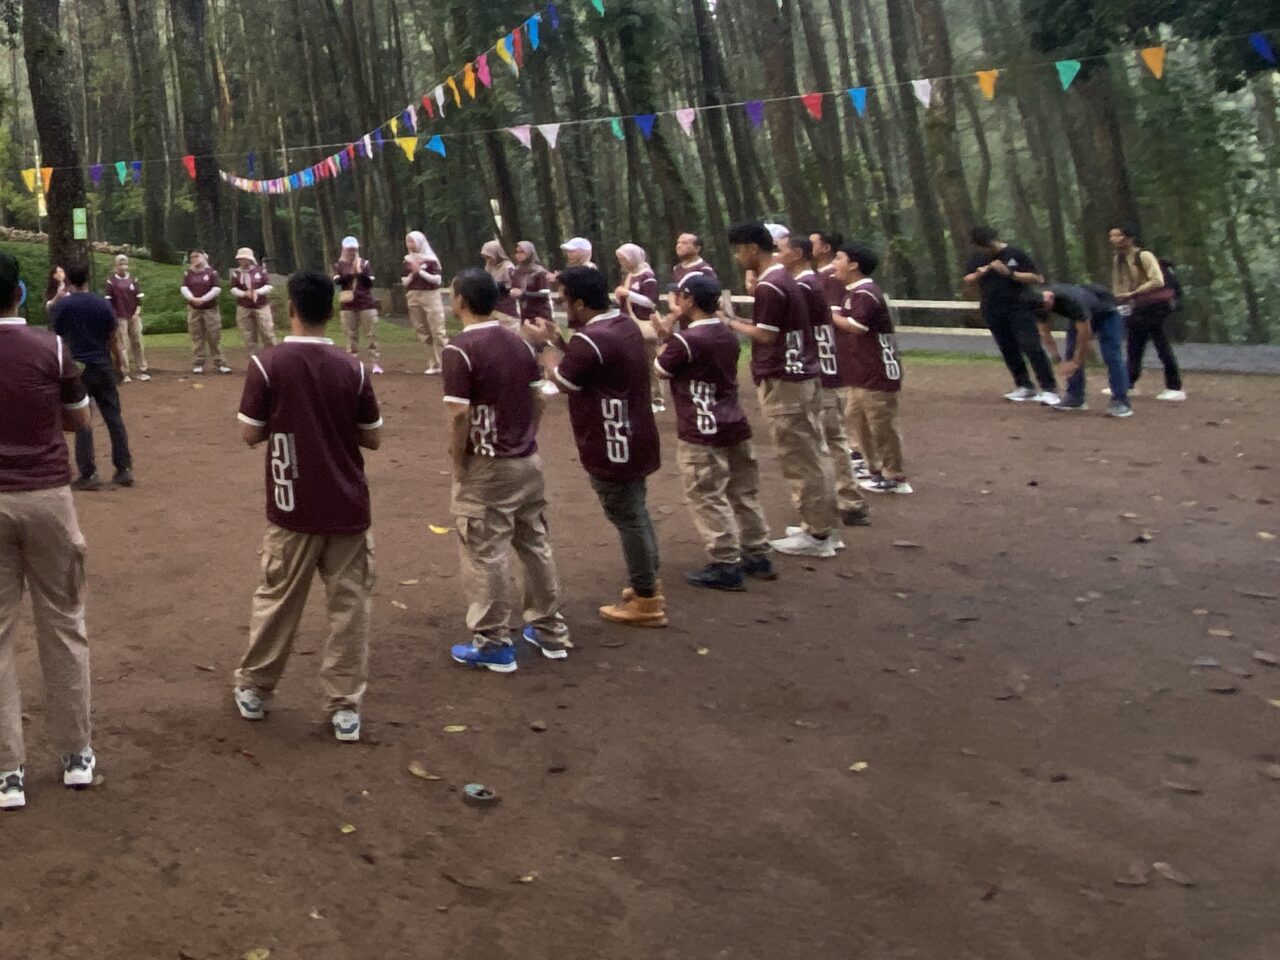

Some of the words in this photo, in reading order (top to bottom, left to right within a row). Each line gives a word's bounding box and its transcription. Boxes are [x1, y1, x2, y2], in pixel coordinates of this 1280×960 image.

[815, 324, 837, 375] ERS
[601, 398, 629, 462] ERS
[690, 380, 717, 434] ERS
[270, 433, 294, 512] ERS
